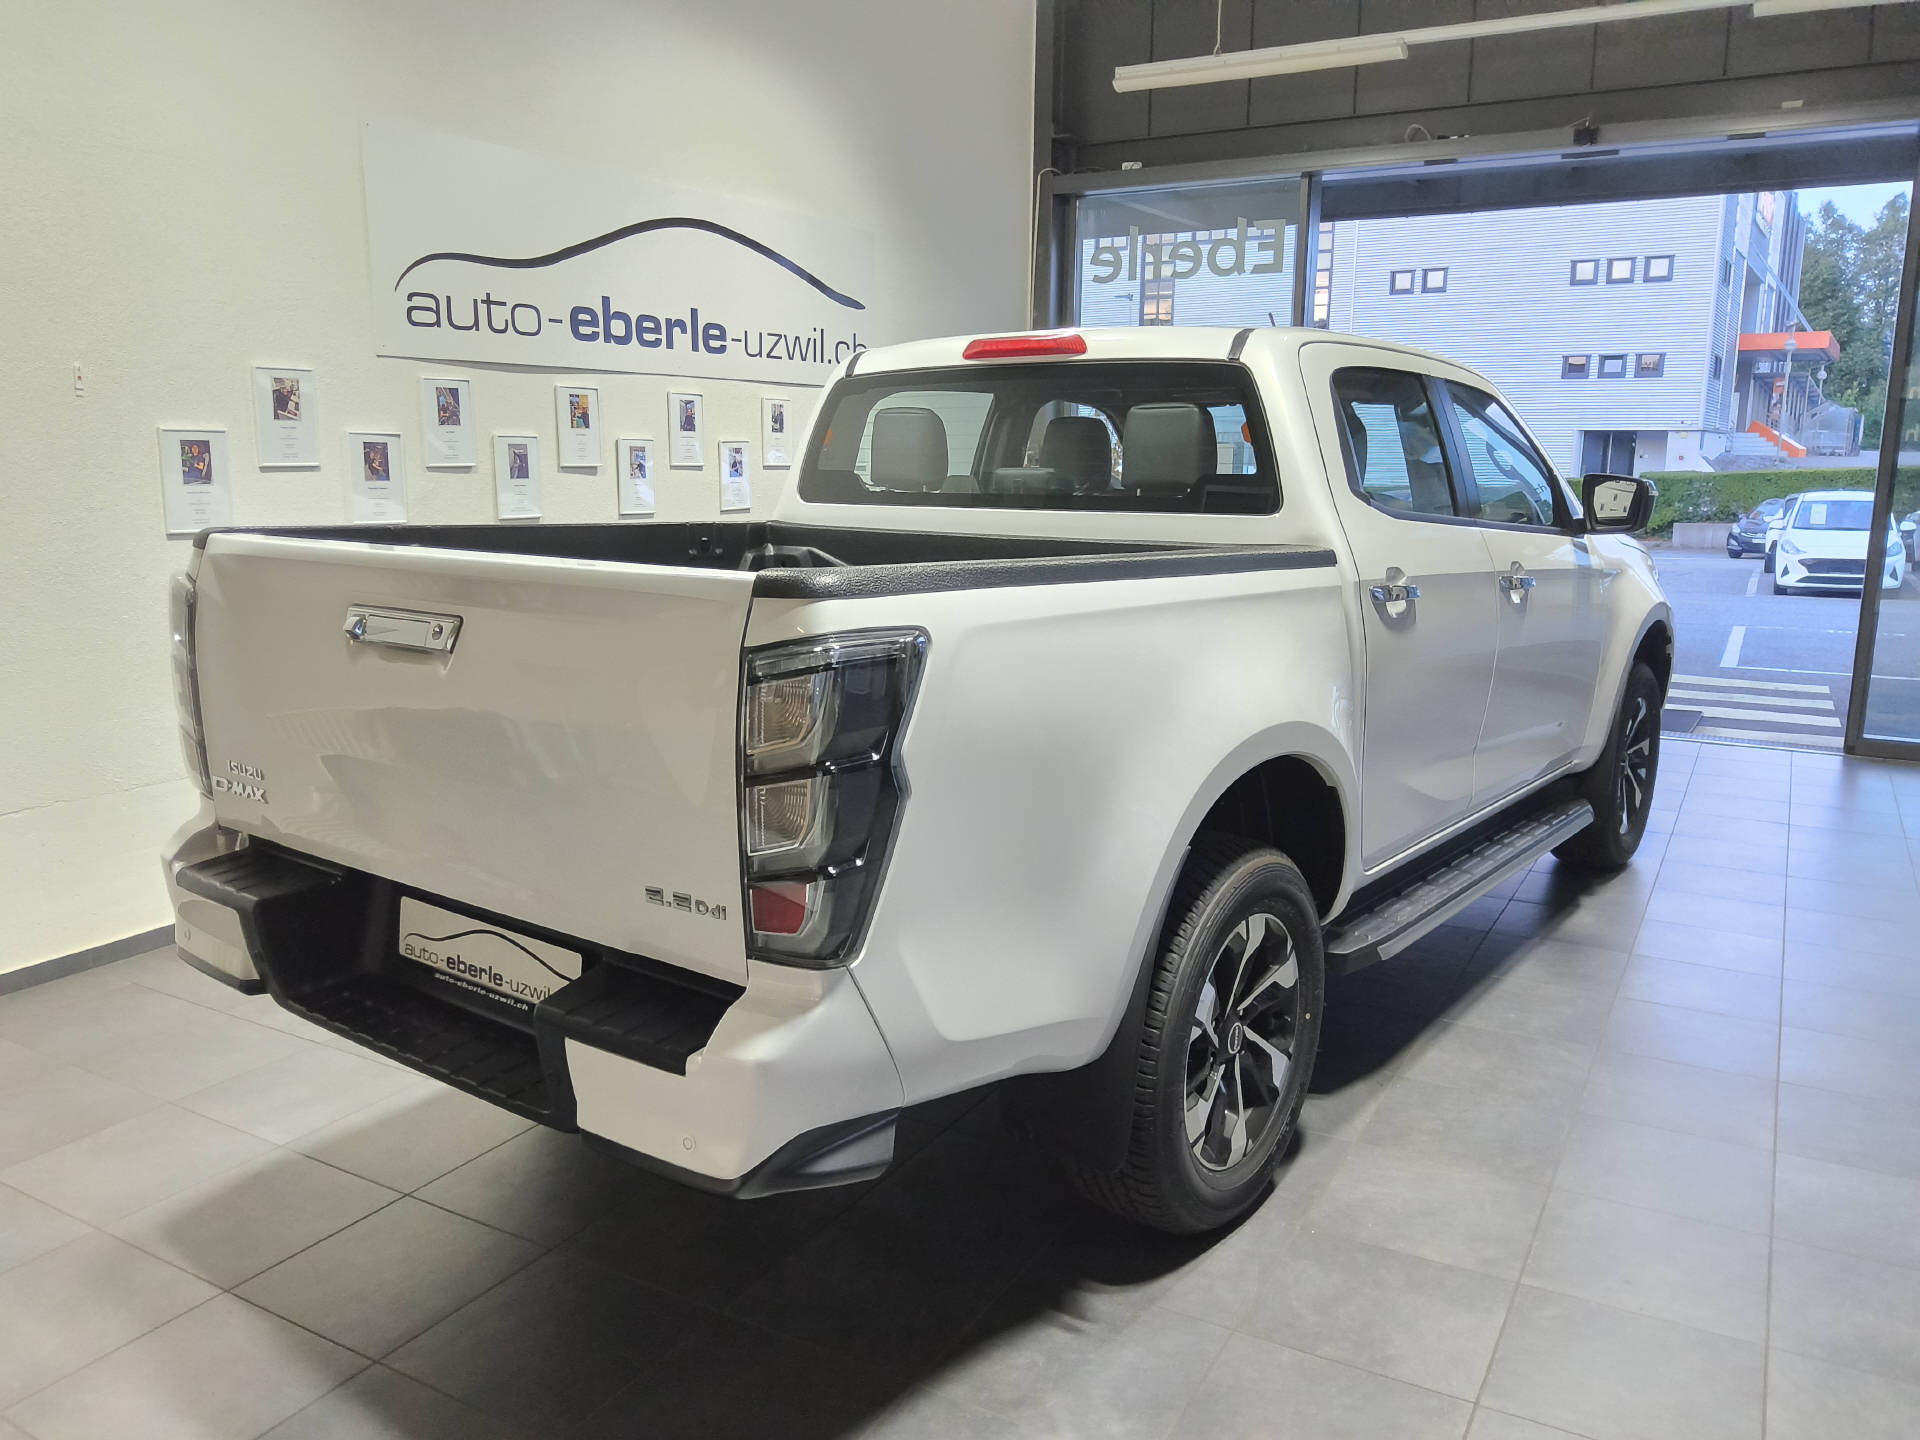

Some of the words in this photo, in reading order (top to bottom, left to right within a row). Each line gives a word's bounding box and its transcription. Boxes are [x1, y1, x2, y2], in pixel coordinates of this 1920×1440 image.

[405, 291, 867, 364] auto-eberle-uzwil.ch
[227, 760, 264, 781] ISUZU
[213, 776, 267, 803] D-MAX
